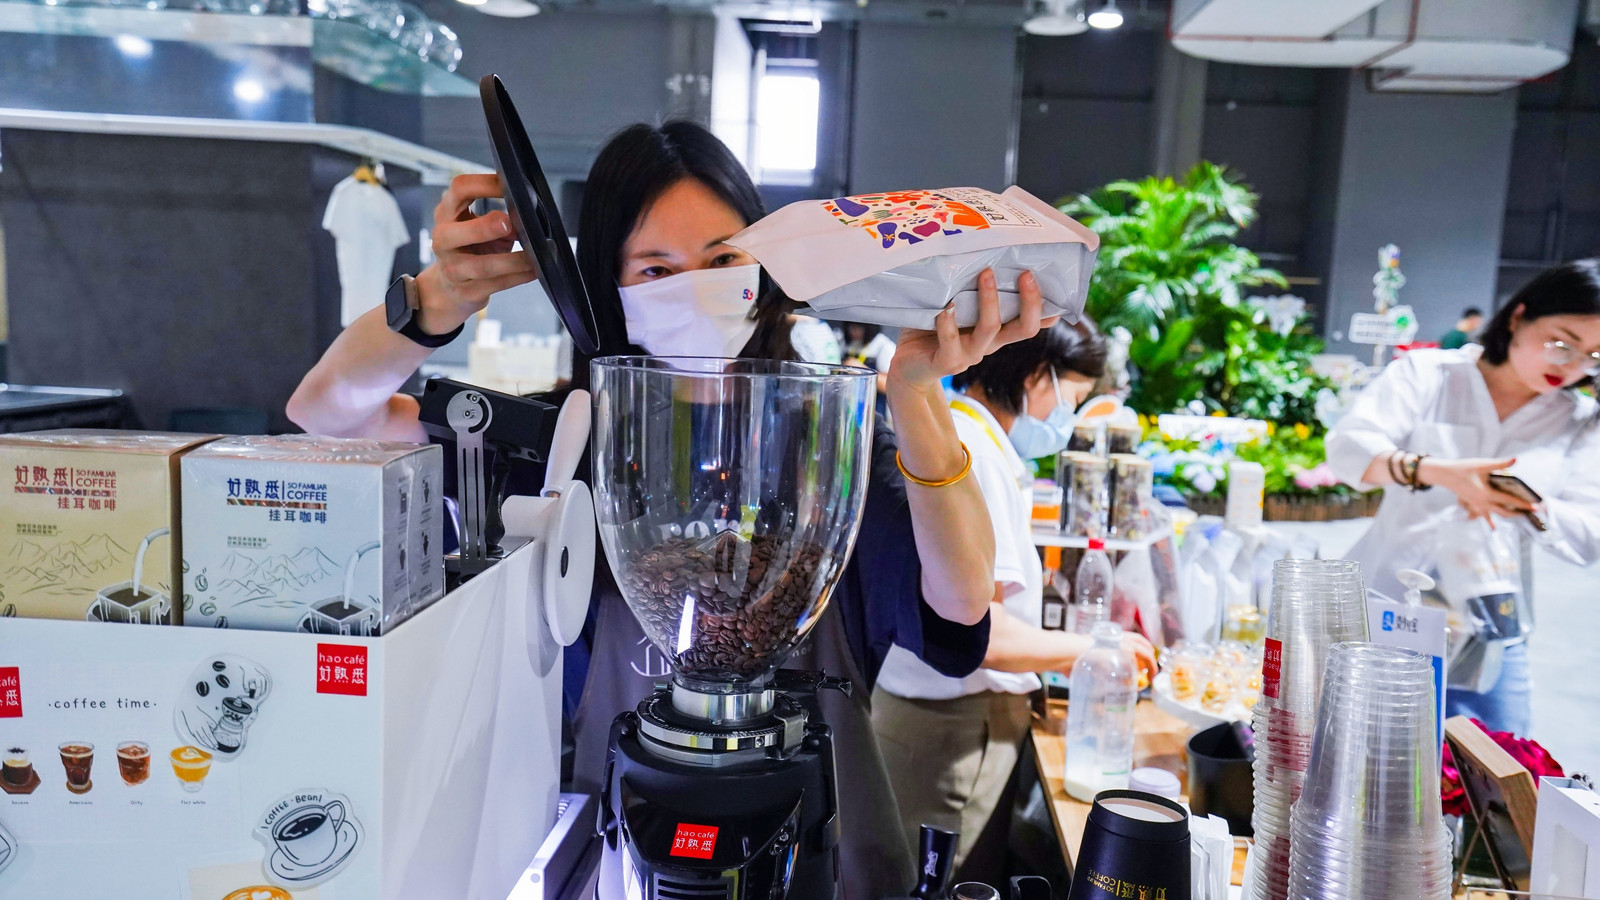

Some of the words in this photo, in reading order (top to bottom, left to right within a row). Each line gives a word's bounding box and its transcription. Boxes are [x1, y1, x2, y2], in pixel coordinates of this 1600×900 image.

[14, 465, 68, 487] 好熟悉
[76, 469, 86, 477] SO
[87, 470, 117, 478] FAMILIAR
[75, 478, 117, 489] COFFEE
[227, 478, 280, 500] 好熟悉
[287, 482, 298, 490] SO
[298, 483, 328, 491] FAMILIAR
[287, 490, 327, 501] COFFEE
[57, 496, 117, 512] 挂耳咖啡
[269, 509, 327, 524] 挂耳咖啡
[319, 652, 342, 664] hao
[343, 654, 365, 665] café
[0, 676, 17, 687] afé
[319, 665, 365, 685] 好熟悉
[677, 829, 696, 837] hao
[673, 837, 713, 851] 好熟悉
